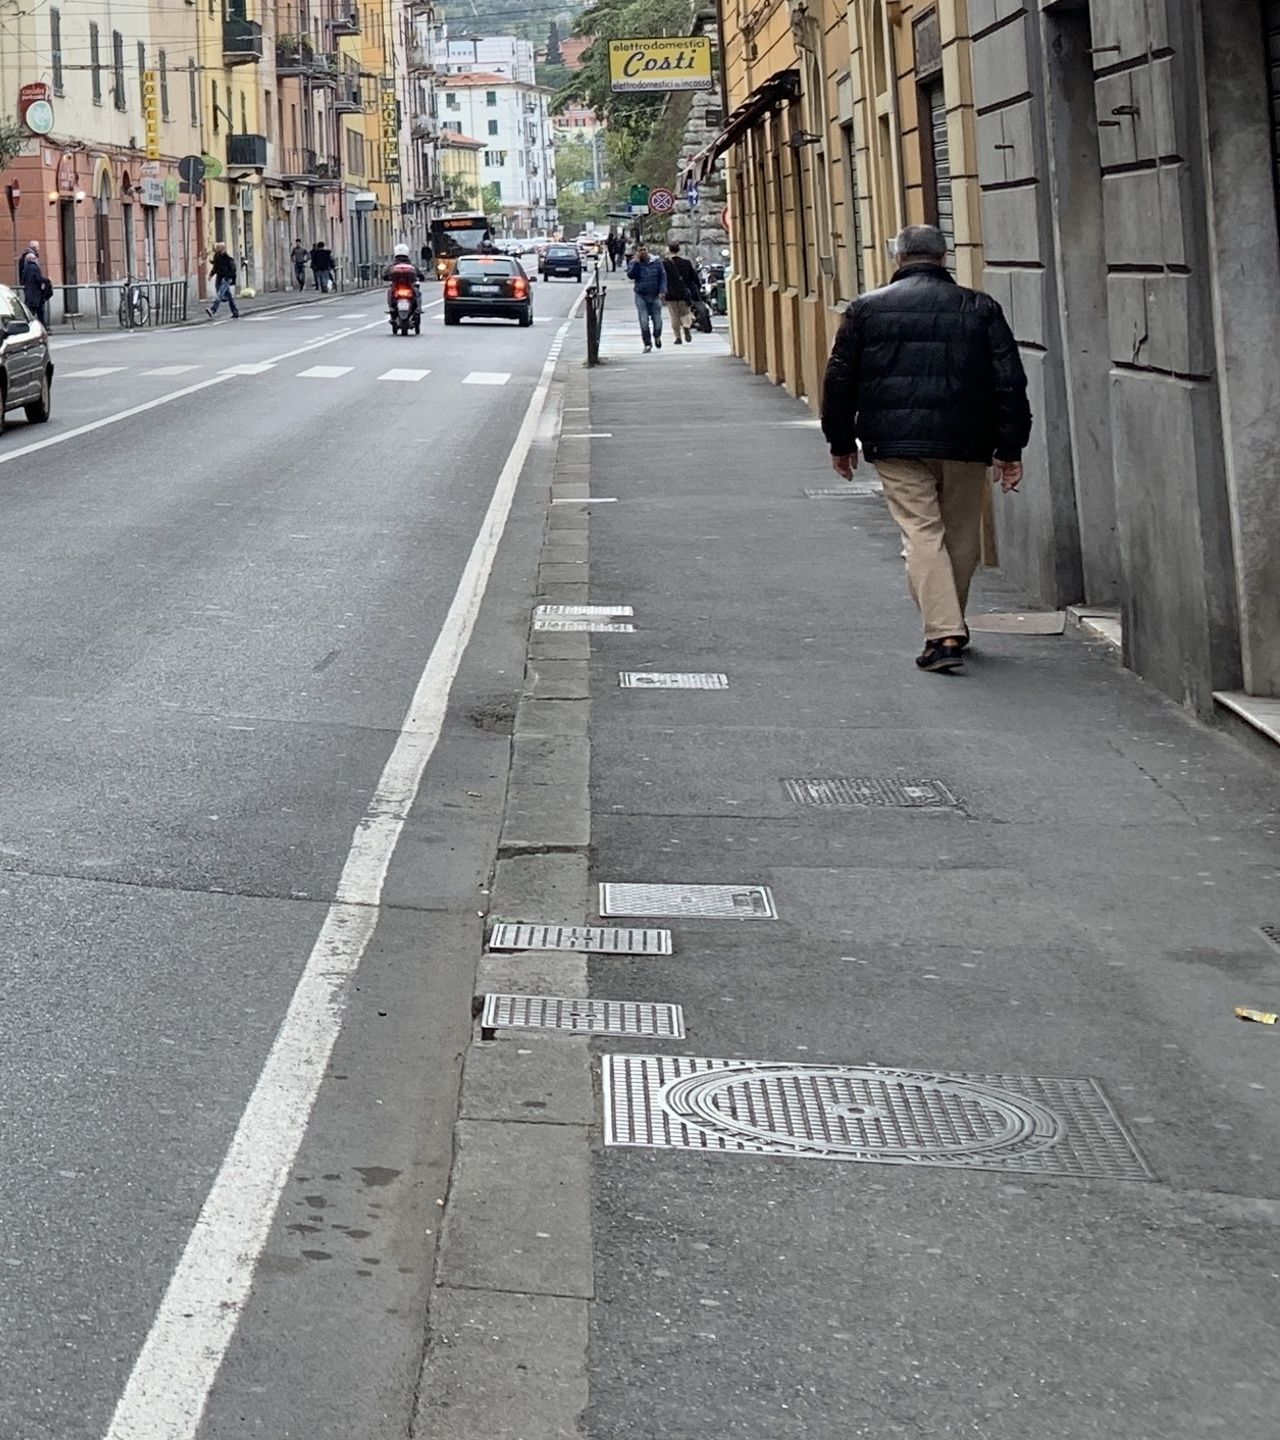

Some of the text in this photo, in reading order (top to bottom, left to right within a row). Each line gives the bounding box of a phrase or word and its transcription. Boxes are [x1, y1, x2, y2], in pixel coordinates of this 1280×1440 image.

[613, 40, 705, 52] elettrodomestici
[623, 49, 697, 77] Costi
[612, 79, 673, 90] elettrodomestici
[681, 79, 711, 88] incasso
[383, 93, 397, 170] HOTEL
